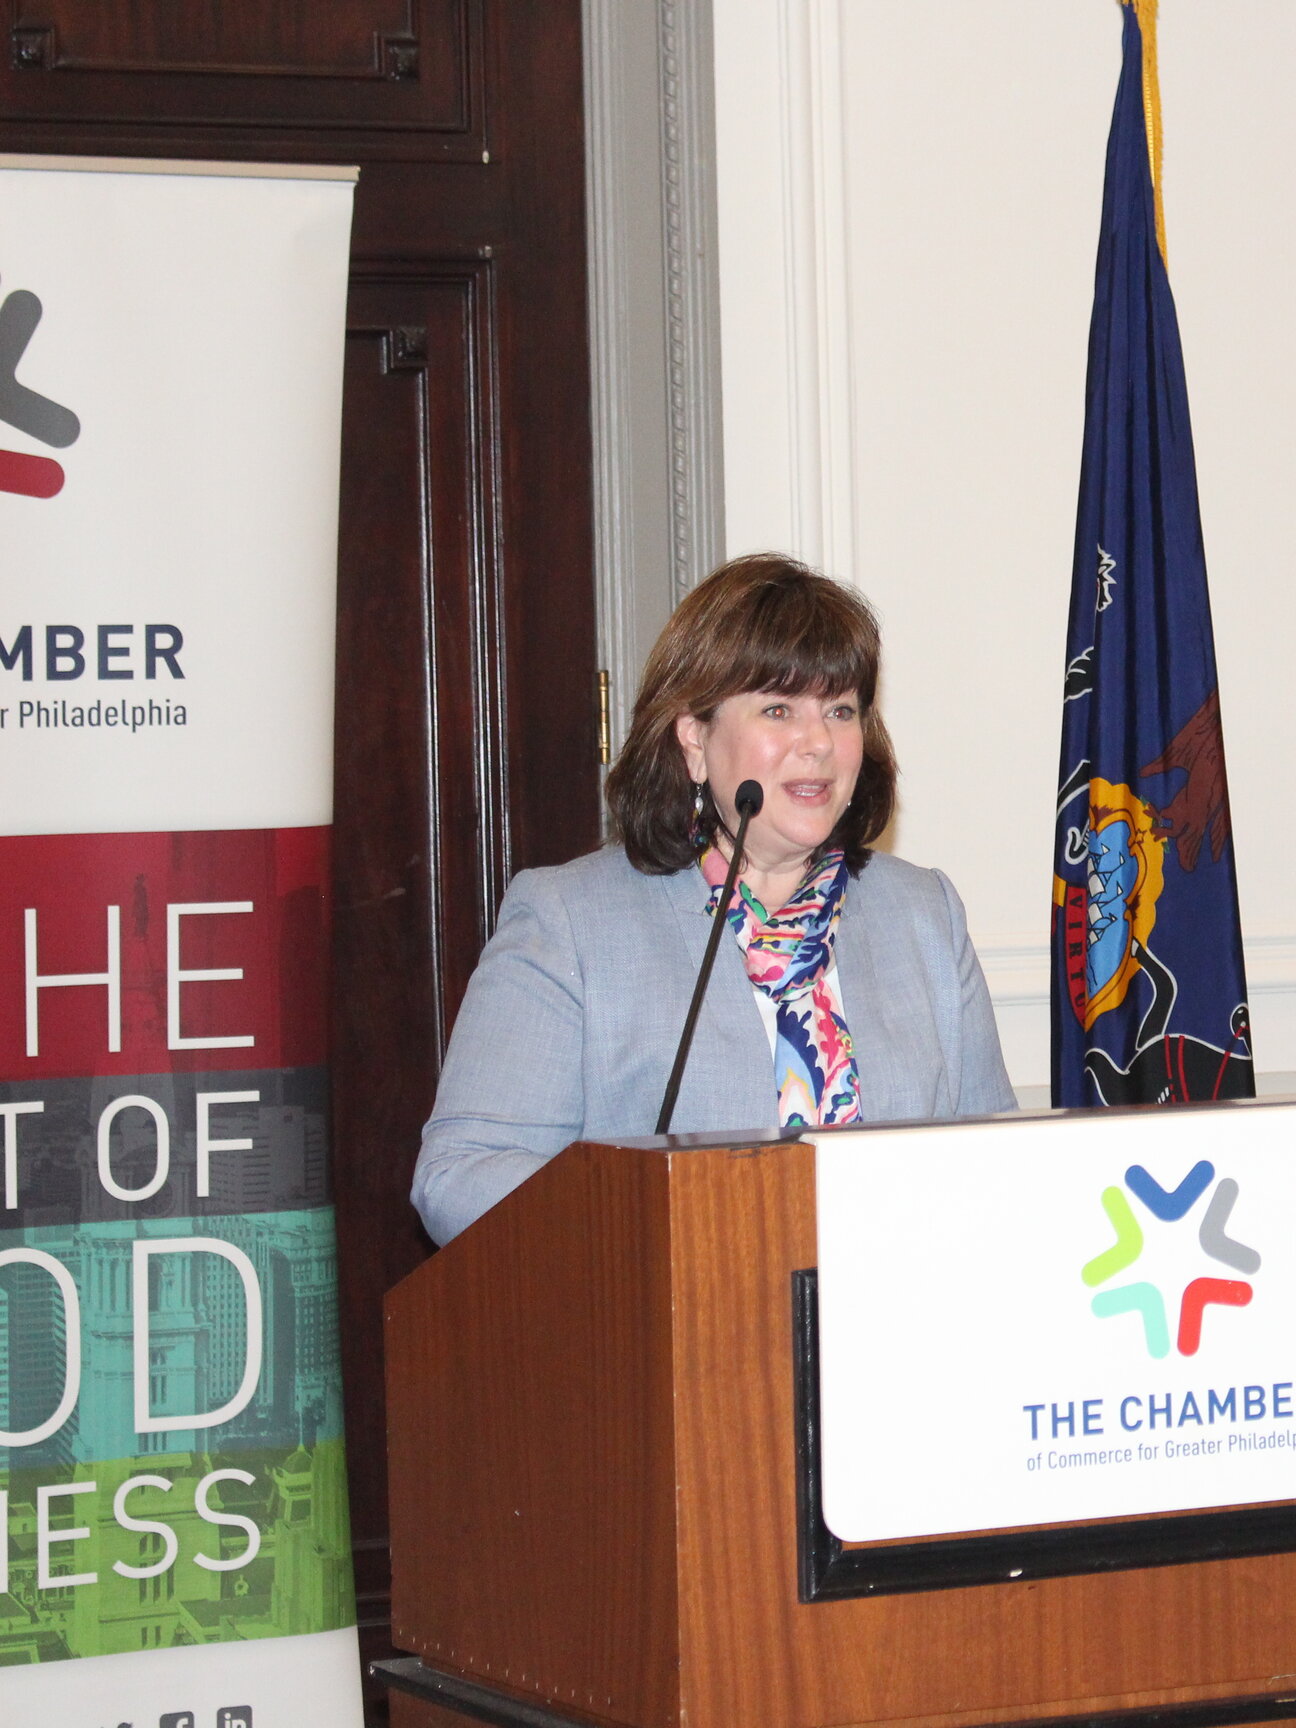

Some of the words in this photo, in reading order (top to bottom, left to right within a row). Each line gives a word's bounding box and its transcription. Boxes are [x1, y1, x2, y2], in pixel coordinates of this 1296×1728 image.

[0, 624, 186, 682] MBER
[19, 698, 187, 733] Philadelphia
[25, 901, 255, 1057] HE
[1068, 894, 1086, 1024] VIRTU
[0, 1101, 44, 1210] T
[97, 1090, 260, 1202] OF
[0, 1237, 263, 1447] OD
[1023, 1399, 1104, 1441] THE
[1026, 1453, 1043, 1471] of
[1048, 1447, 1133, 1470] Commerce
[1138, 1443, 1159, 1461] for
[1165, 1435, 1224, 1459] Greater
[0, 1468, 261, 1594] ESS
